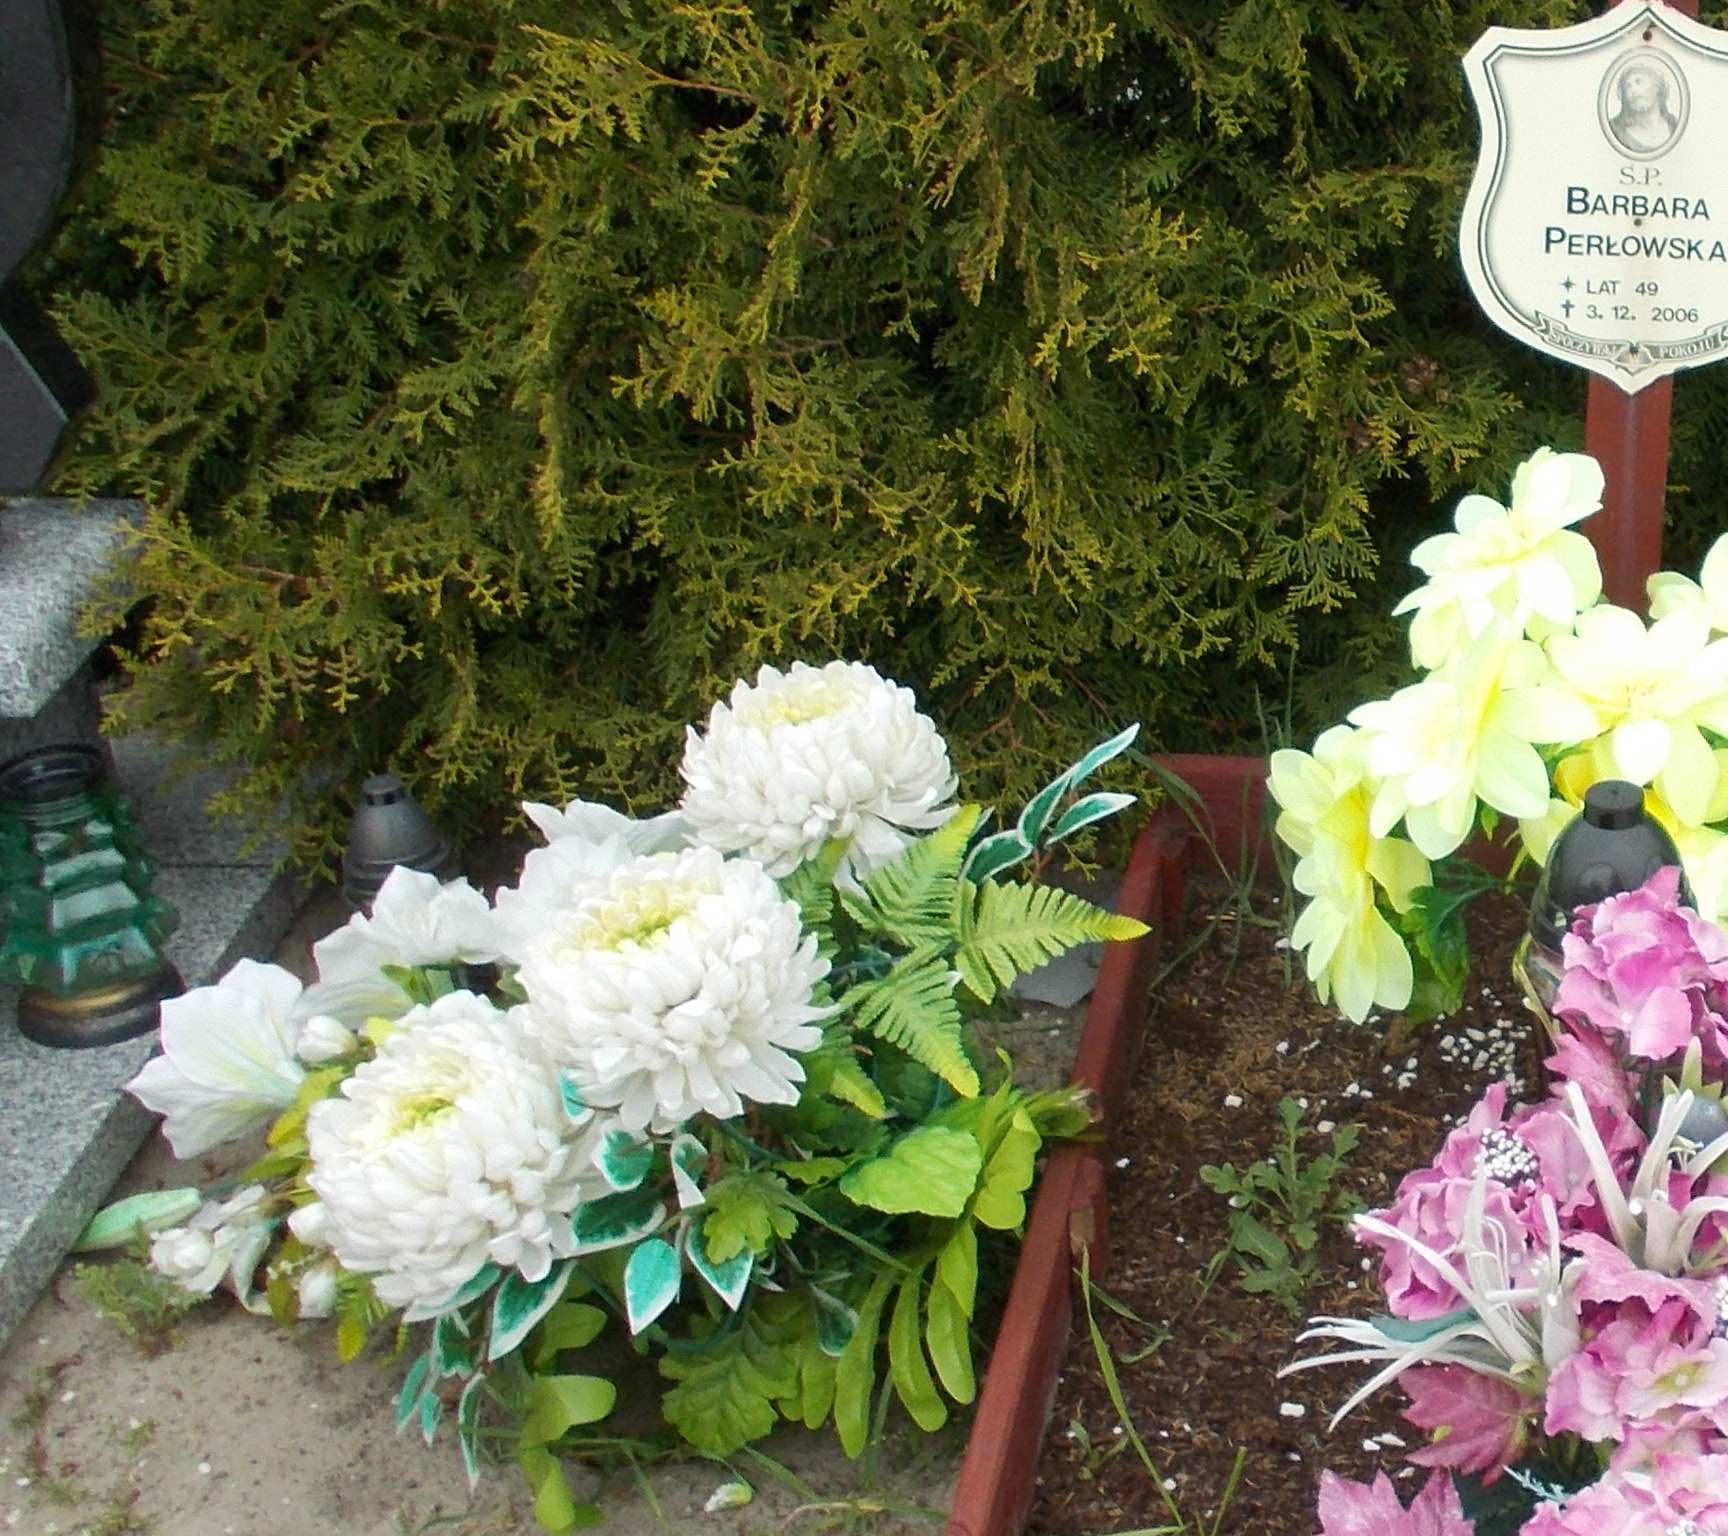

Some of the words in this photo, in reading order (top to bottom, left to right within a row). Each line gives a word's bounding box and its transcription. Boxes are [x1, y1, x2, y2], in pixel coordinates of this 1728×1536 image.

[1566, 186, 1711, 221] BARBARA
[1544, 226, 1728, 262] PERŁOWSKA
[1586, 280, 1621, 296] LAT
[1634, 281, 1659, 296] 49
[1586, 304, 1604, 319] 3.
[1611, 305, 1637, 321] 12.
[1651, 306, 1699, 322] 2006
[1658, 336, 1715, 360] POKOJU
